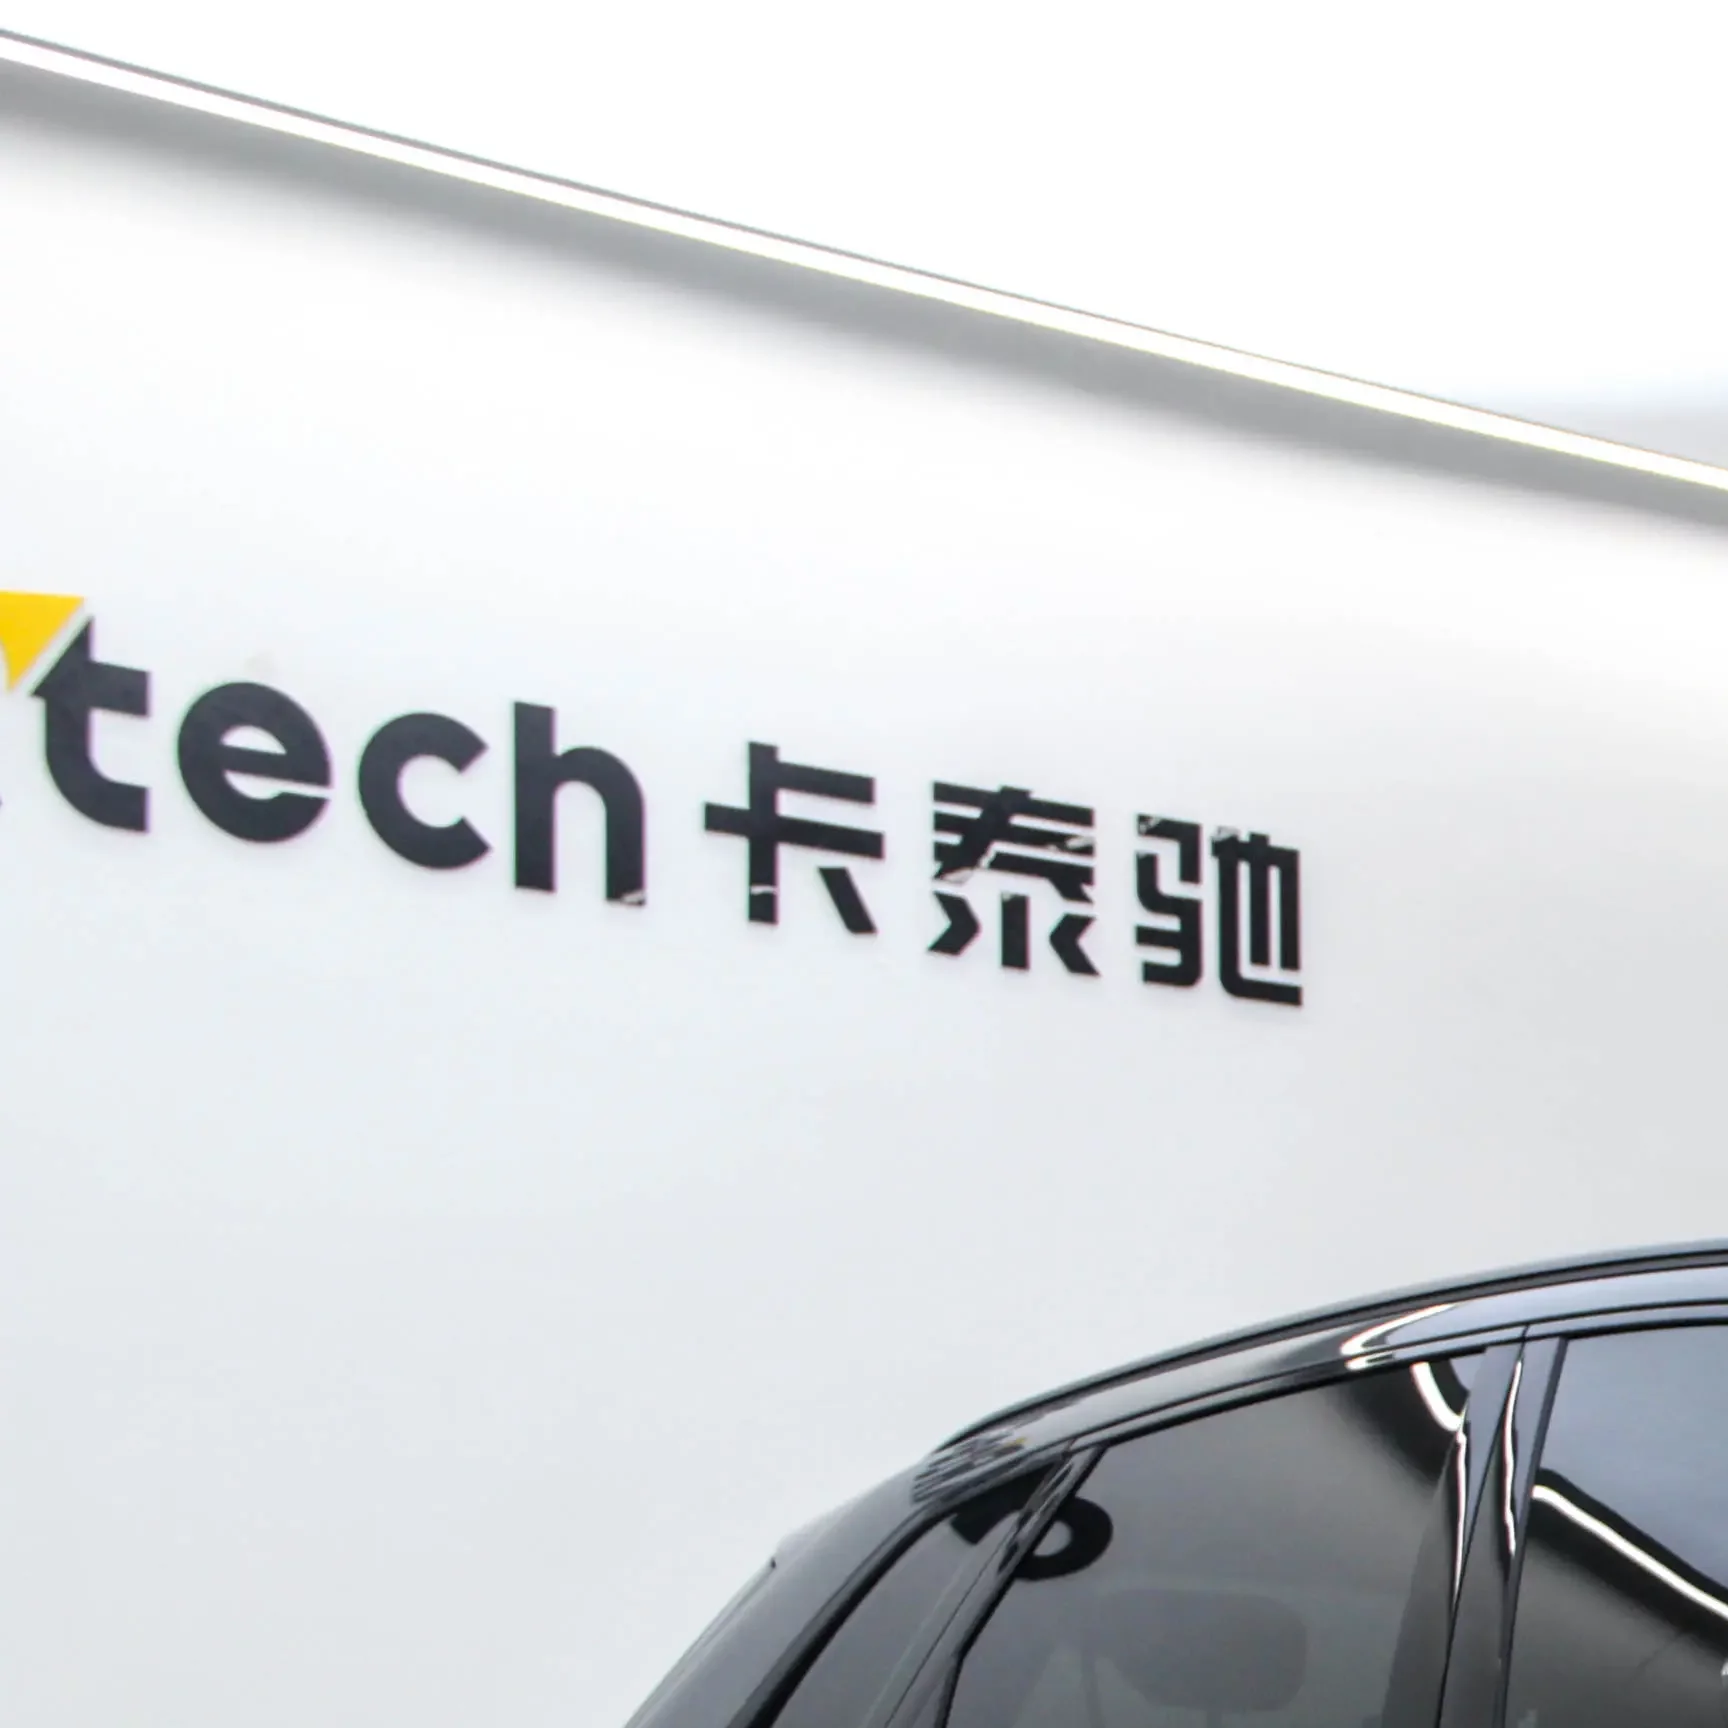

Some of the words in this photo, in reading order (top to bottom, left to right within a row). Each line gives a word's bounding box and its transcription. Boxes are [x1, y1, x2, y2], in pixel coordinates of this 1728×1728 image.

[0, 592, 646, 906] tech
[704, 742, 1302, 1008] 卡泰驰
